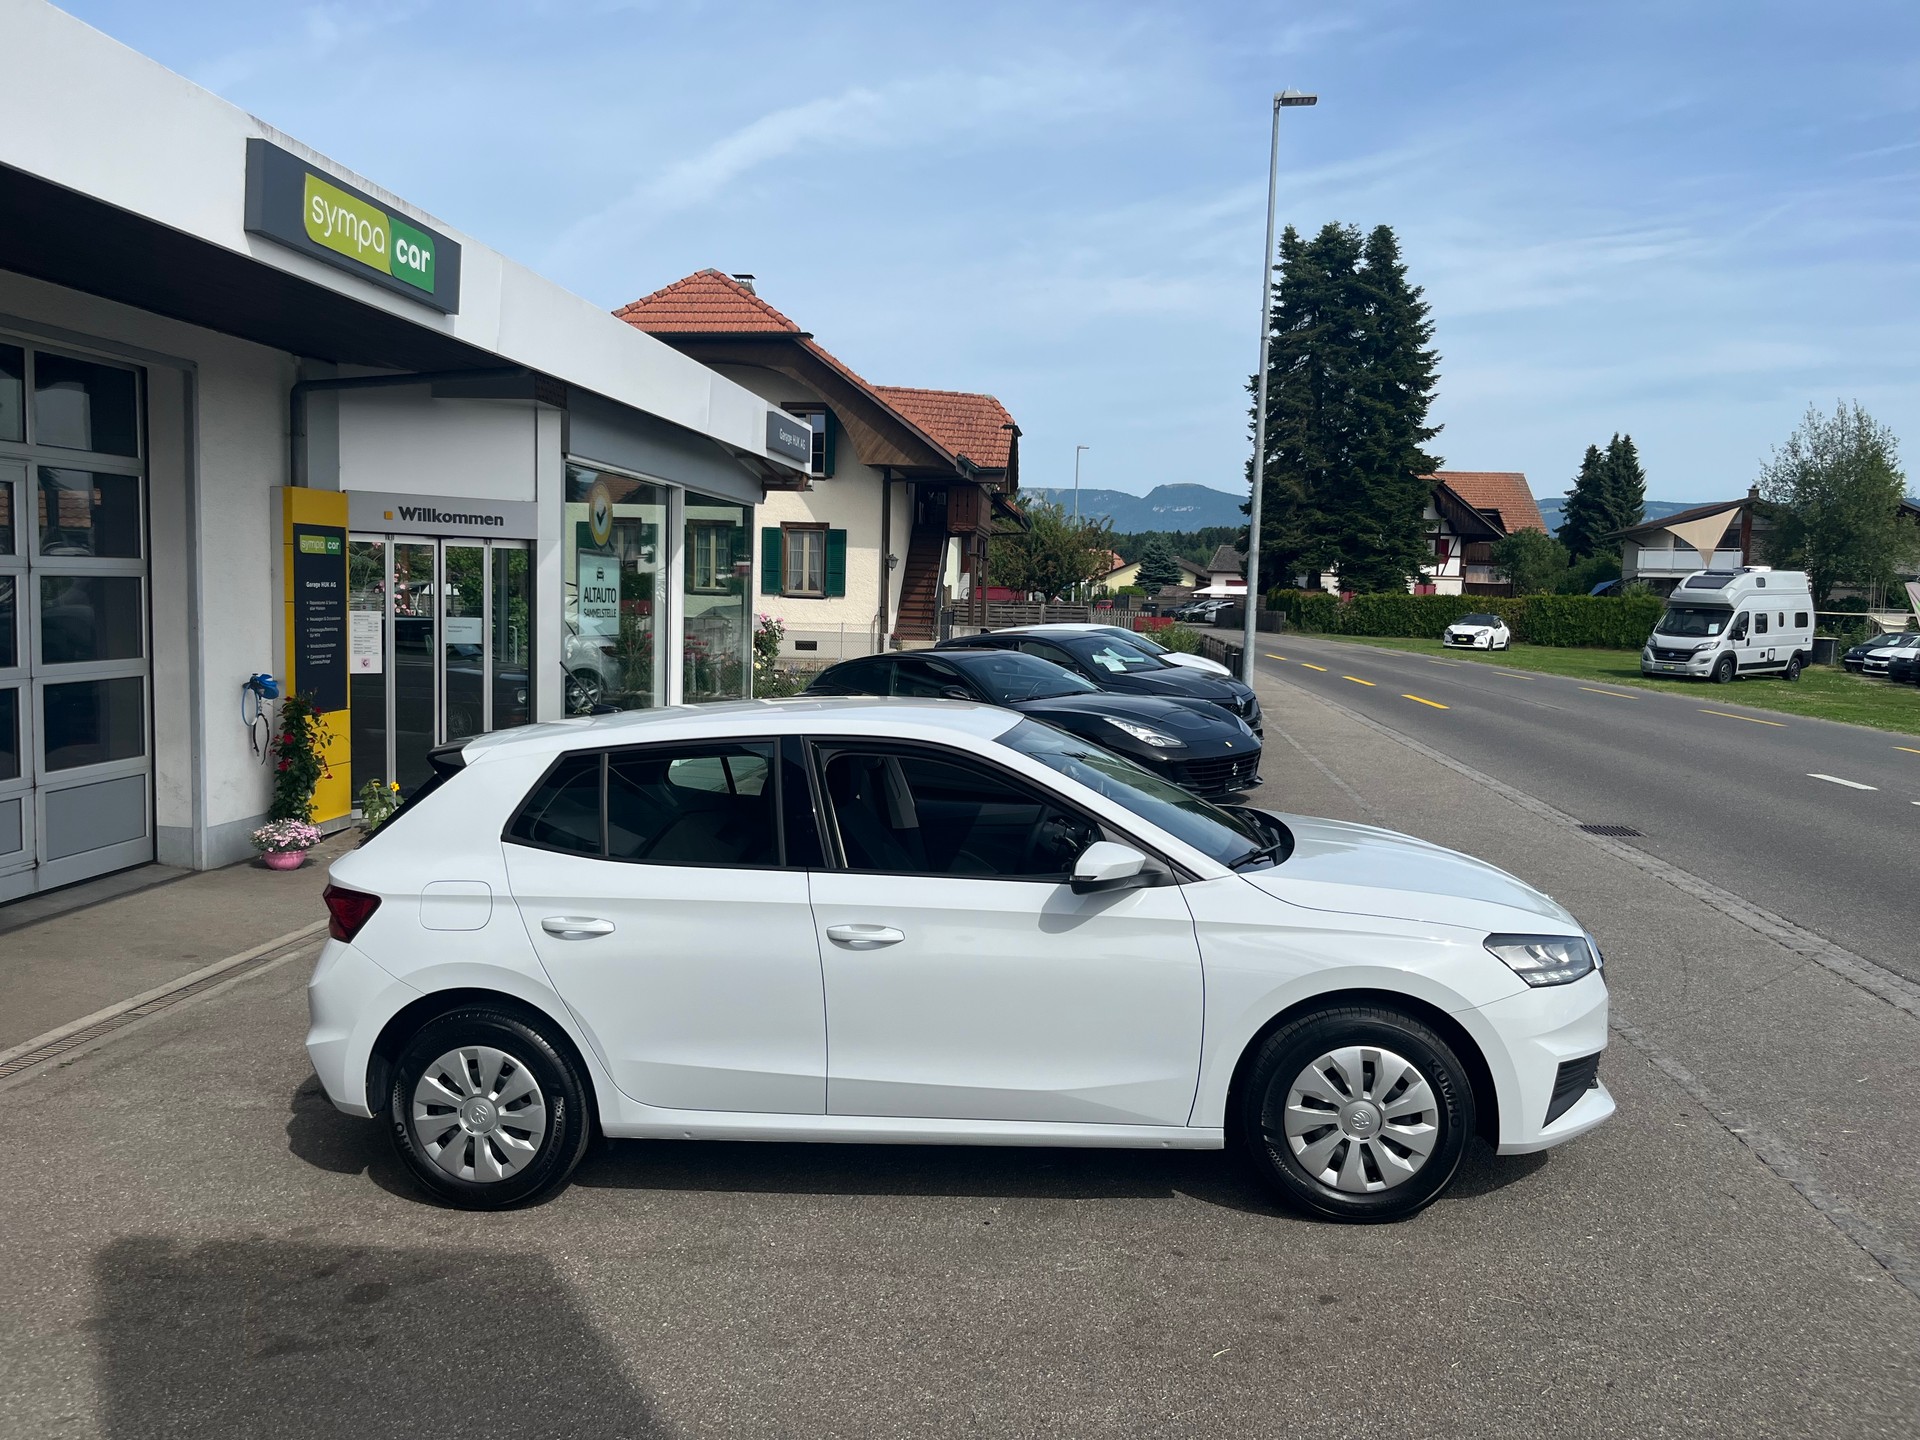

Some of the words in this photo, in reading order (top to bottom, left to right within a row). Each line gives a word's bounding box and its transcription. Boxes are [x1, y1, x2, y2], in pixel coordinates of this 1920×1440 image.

[312, 195, 385, 254] sympa
[397, 239, 430, 272] car
[399, 506, 504, 526] Willkommen
[301, 539, 325, 551] sympa
[327, 541, 340, 550] car
[584, 587, 616, 603] ALTAUTO
[584, 608, 616, 618] SAMMELSTELLE
[1427, 1059, 1460, 1128] KUMHO
